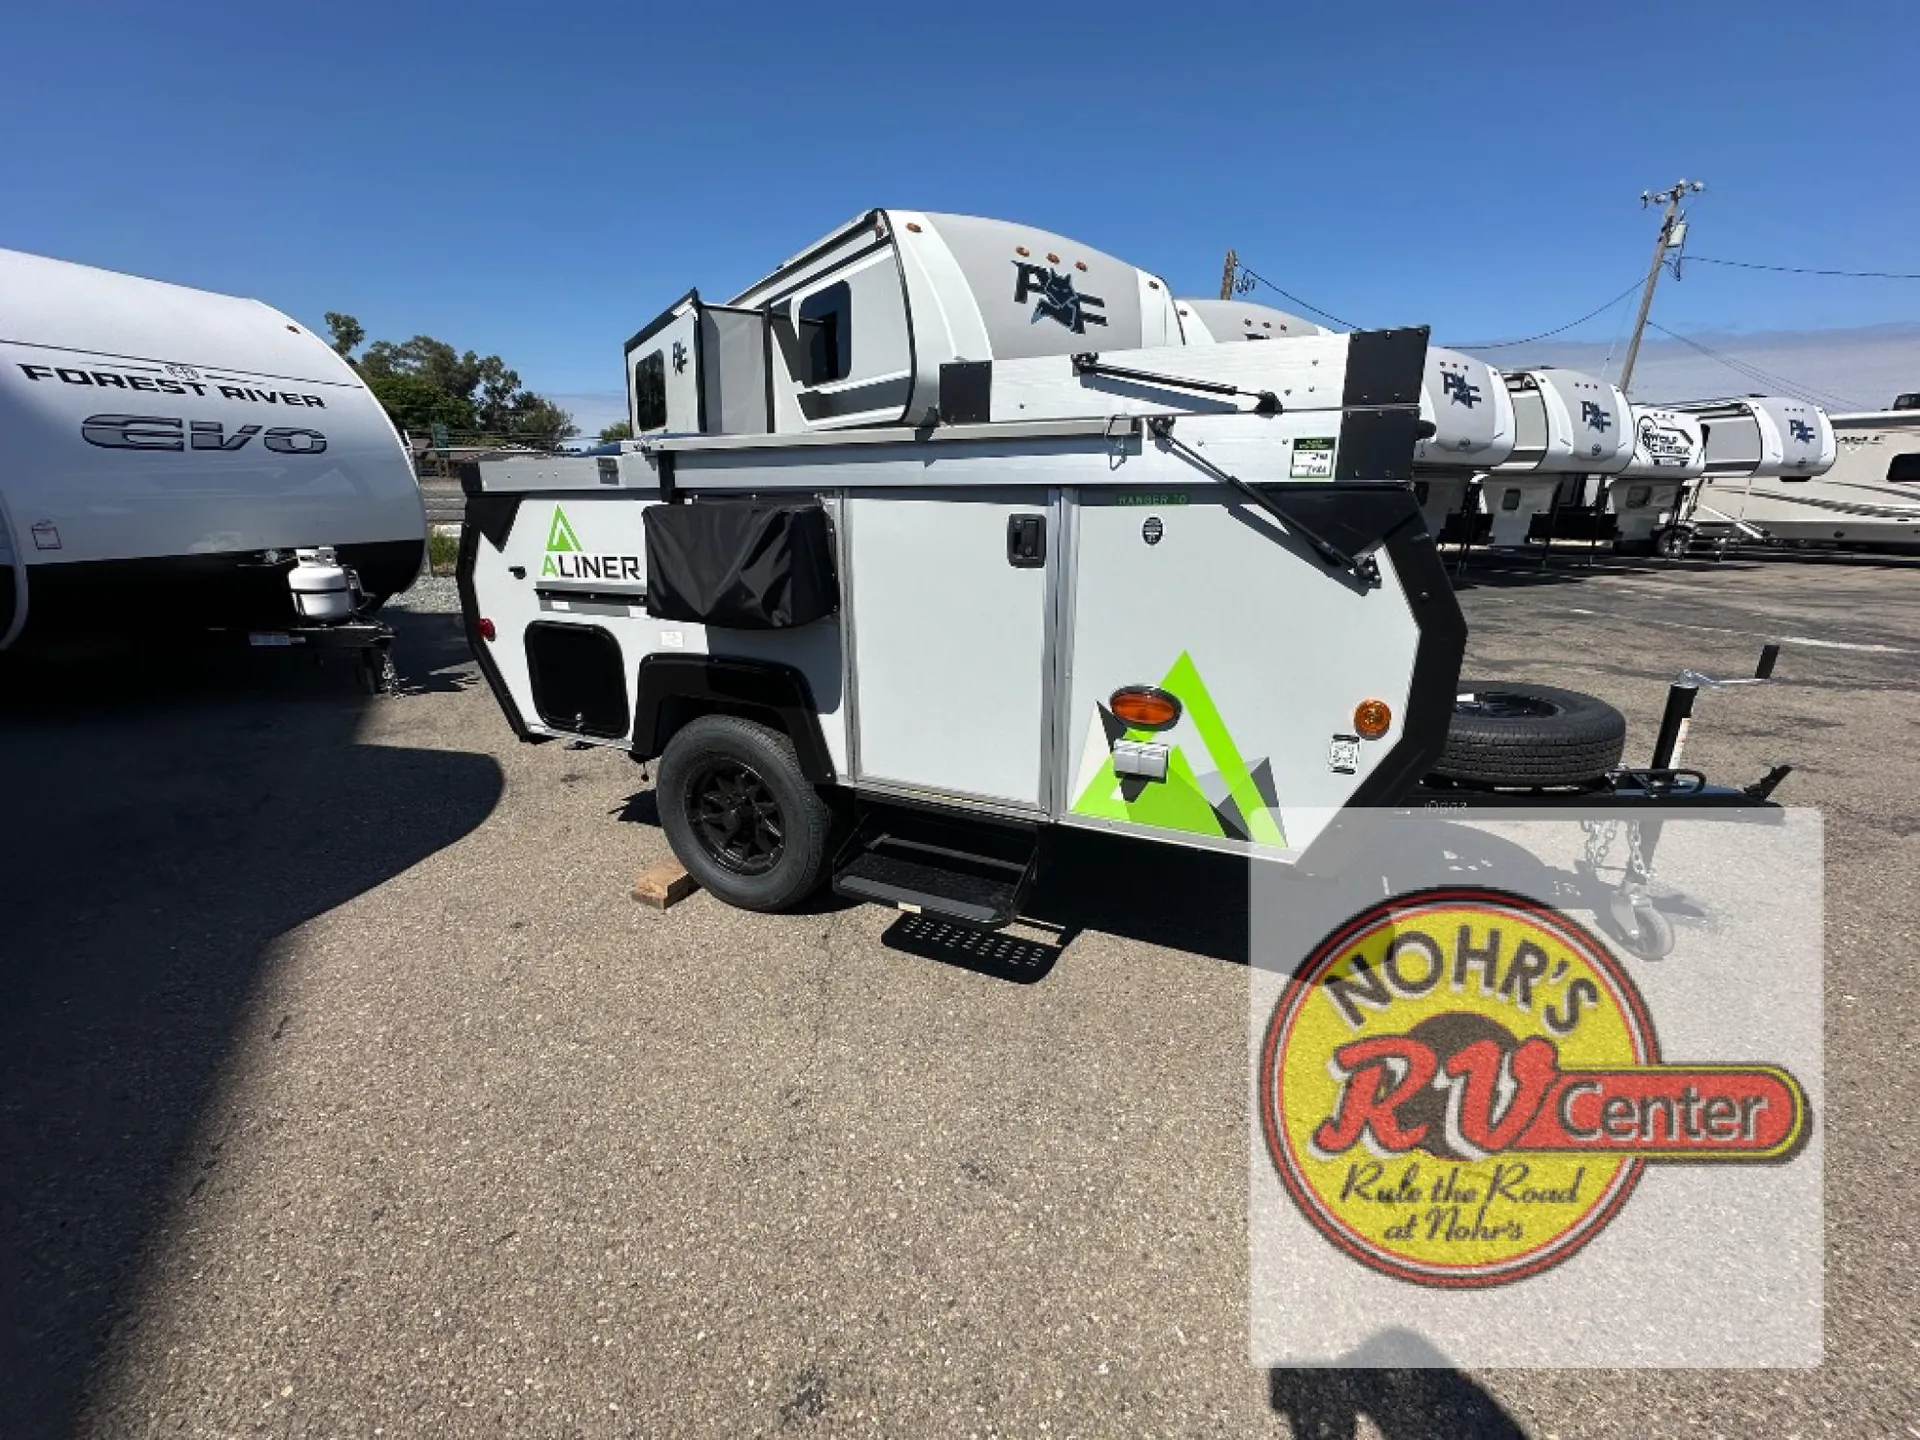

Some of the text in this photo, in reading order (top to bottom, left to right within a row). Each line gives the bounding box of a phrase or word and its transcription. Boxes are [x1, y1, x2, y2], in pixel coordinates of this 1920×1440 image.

[17, 363, 207, 396] FOREST
[218, 385, 328, 409] RIVER
[1119, 495, 1169, 505] RANGER
[541, 554, 641, 580] ALINER
